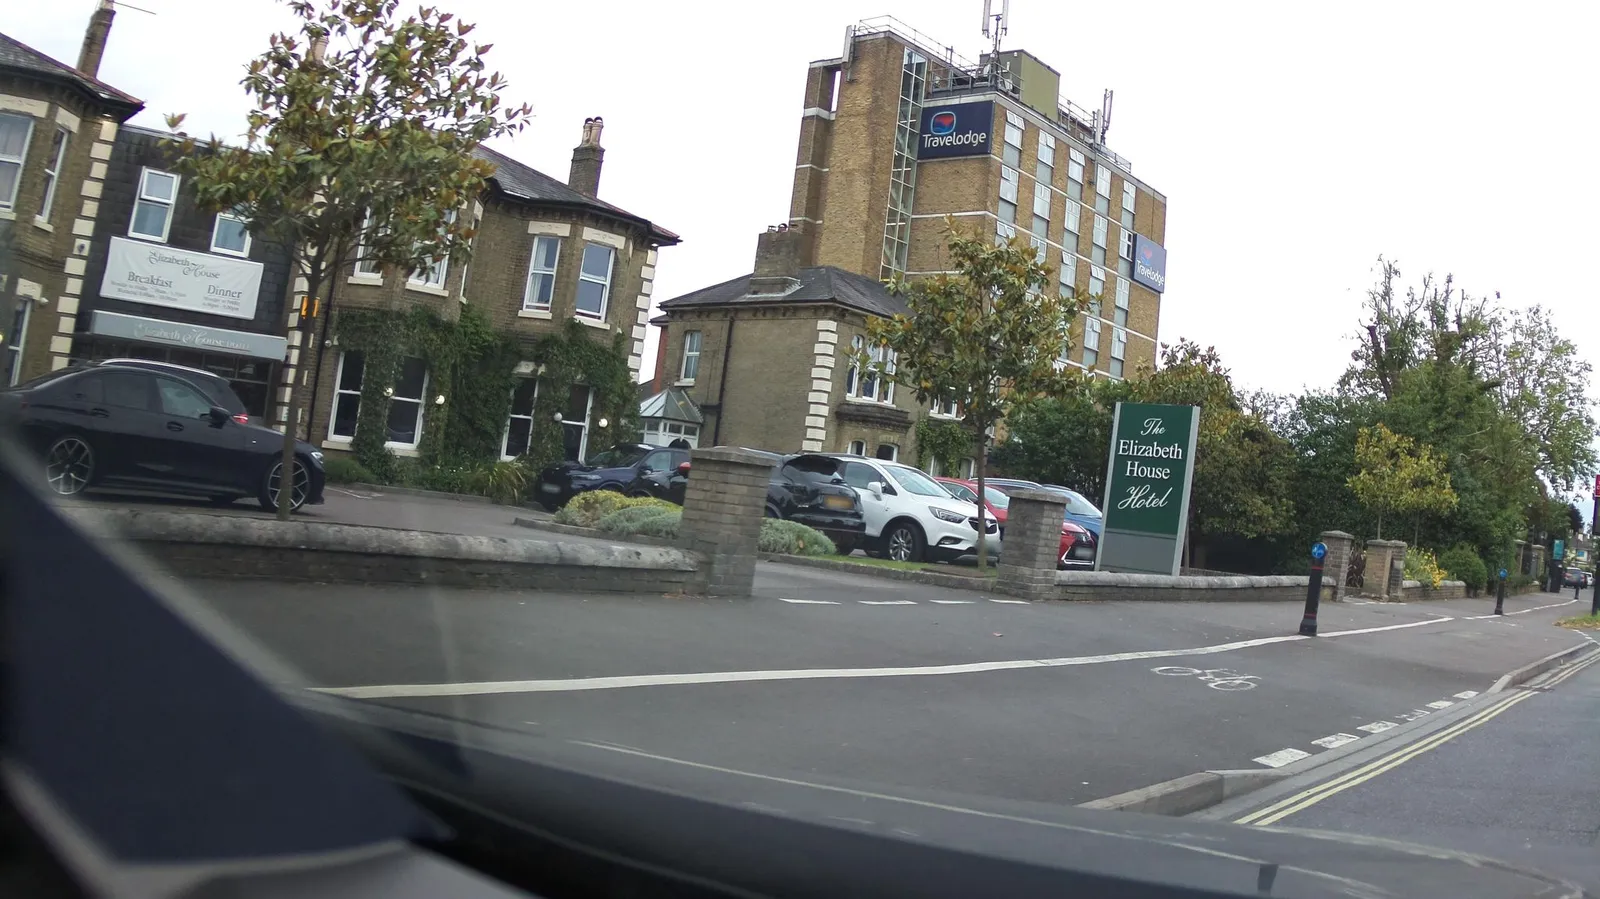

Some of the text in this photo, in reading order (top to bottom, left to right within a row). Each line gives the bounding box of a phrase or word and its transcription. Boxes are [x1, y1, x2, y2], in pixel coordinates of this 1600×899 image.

[922, 130, 987, 148] Travelodge
[148, 250, 221, 279] Elizabeth House
[1136, 259, 1165, 286] Travelodge
[127, 271, 173, 288] Breakfast
[207, 284, 243, 299] Dinner
[133, 322, 181, 341] Elizabeth
[182, 328, 224, 346] House
[1140, 417, 1166, 436] The
[1117, 439, 1183, 459] Elizabeth
[1125, 460, 1171, 480] House
[1117, 484, 1173, 510] Hotel
